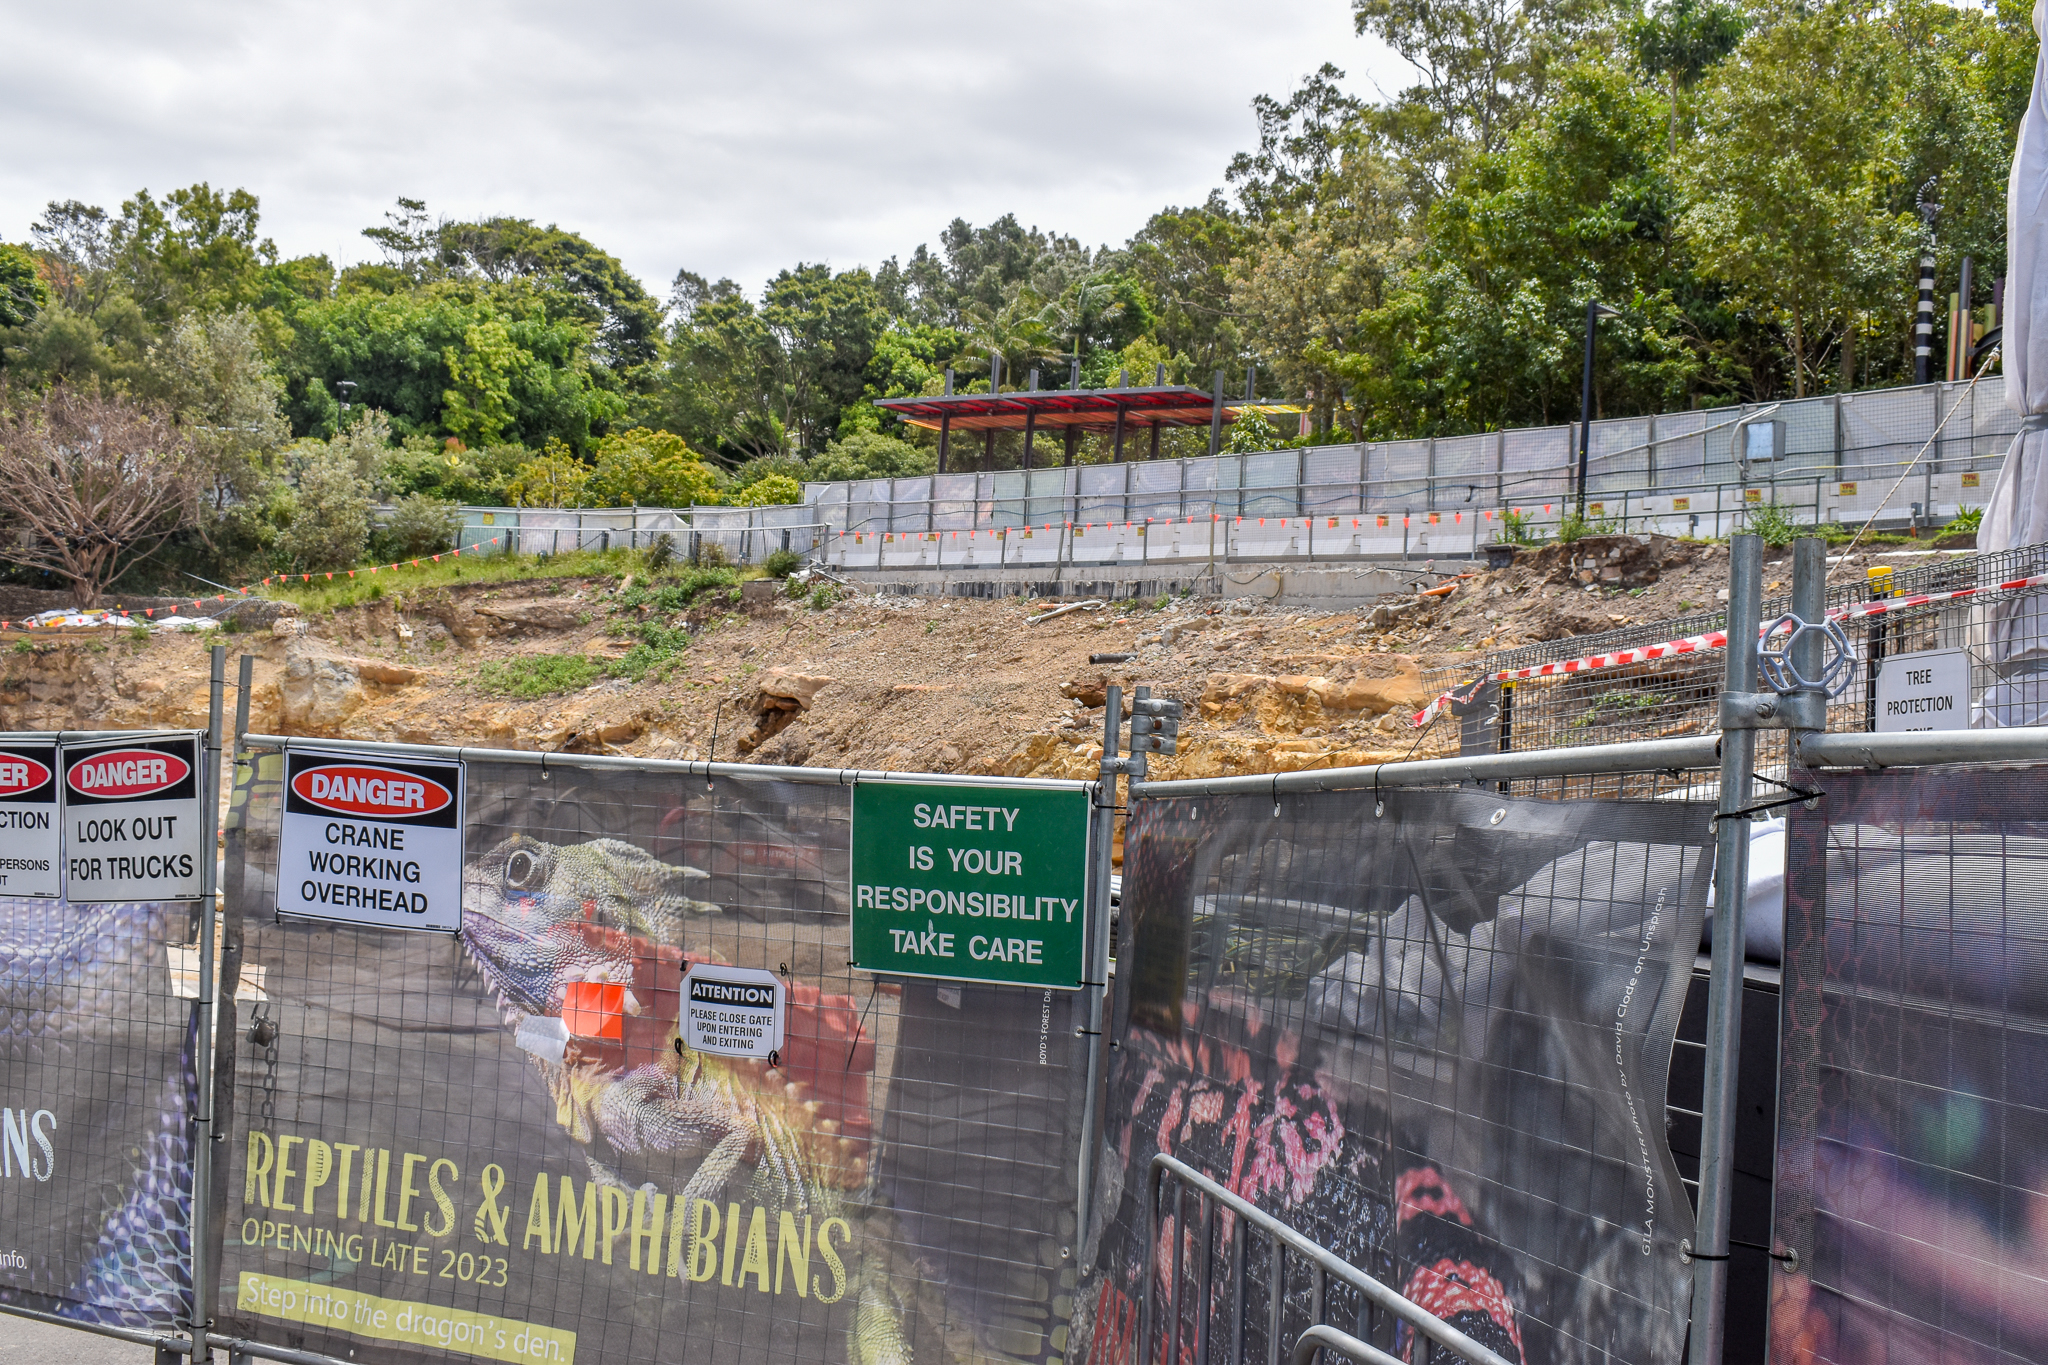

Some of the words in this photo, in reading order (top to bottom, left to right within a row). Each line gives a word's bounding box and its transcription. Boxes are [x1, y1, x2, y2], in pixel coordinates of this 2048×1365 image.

[1906, 669, 1932, 685] TREE
[1887, 695, 1953, 715] PROTECTION
[82, 759, 167, 788] DANGER
[311, 773, 425, 808] DANGER
[78, 818, 127, 842] LOOK
[132, 816, 177, 840] OUT
[913, 803, 1020, 831] SAFETY
[325, 822, 404, 850] CRANE
[0, 859, 50, 871] PERSONS
[71, 858, 102, 880] FOR
[107, 854, 193, 879] TRUCKS
[309, 850, 420, 883] WORKING
[909, 846, 934, 870] IS
[947, 848, 1022, 875] YOUR
[301, 880, 428, 914] OVERHEAD
[857, 885, 1078, 922] RESPONSIBILITY
[1640, 887, 1668, 952] Unsplash
[889, 929, 955, 957] TAKE
[968, 935, 1043, 964] CARE
[1634, 956, 1646, 974] on
[692, 983, 772, 1003] ATTENTION
[1044, 988, 1052, 1002] DR
[1617, 977, 1638, 1018] Clode
[691, 1008, 717, 1021] PLEASE
[719, 1012, 746, 1024] CLOSE
[749, 1014, 772, 1026] GATE
[697, 1022, 717, 1033] UPON
[719, 1025, 762, 1037] ENTERING
[1041, 1004, 1050, 1034] FOREST
[702, 1035, 717, 1045] AND
[719, 1037, 754, 1049] EXITING
[1621, 1071, 1628, 1087] by
[1625, 1091, 1643, 1135] photo
[0, 1107, 57, 1182] NS
[1638, 1137, 1655, 1215] MONSTER
[244, 1130, 459, 1237] REPTILES
[474, 1163, 509, 1246] &
[523, 1172, 851, 1304] AMPHIBIANS
[241, 1217, 363, 1263] OPENING
[371, 1238, 430, 1274] LATE
[439, 1250, 509, 1287] 2023
[1641, 1219, 1653, 1256] GILA
[246, 1276, 296, 1315] Step
[303, 1288, 348, 1320] into
[354, 1296, 388, 1329] the
[395, 1305, 506, 1346] dragon's
[513, 1327, 566, 1362] den.
